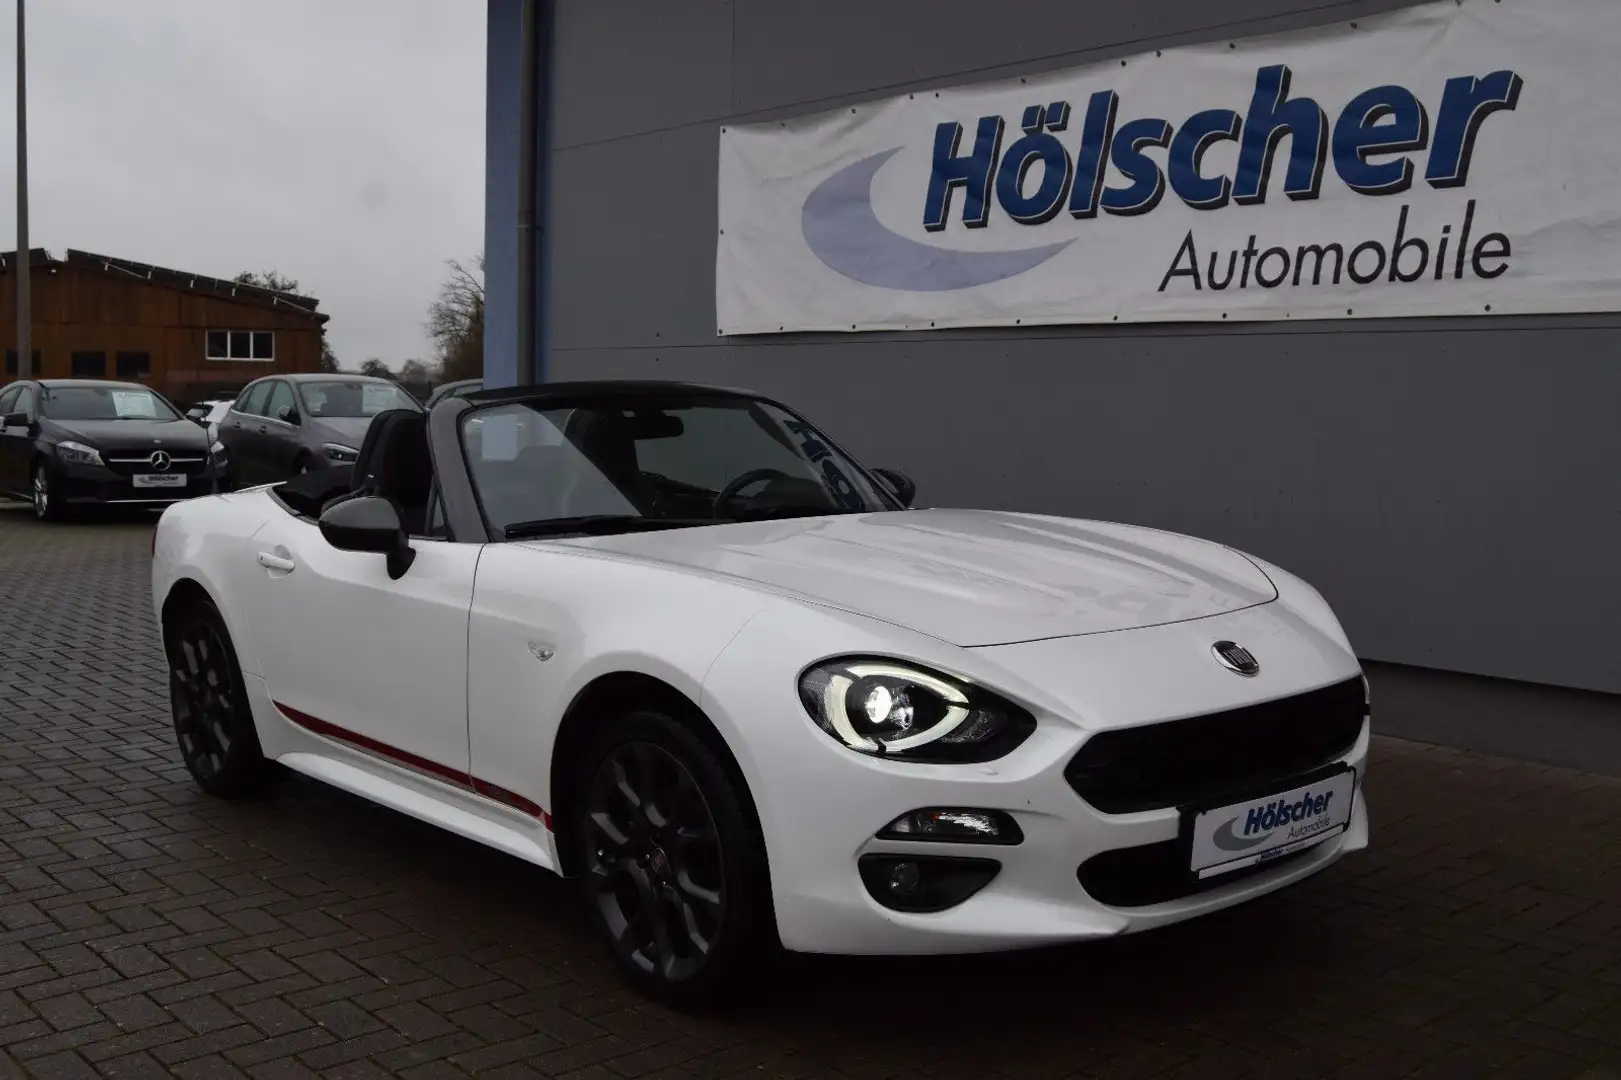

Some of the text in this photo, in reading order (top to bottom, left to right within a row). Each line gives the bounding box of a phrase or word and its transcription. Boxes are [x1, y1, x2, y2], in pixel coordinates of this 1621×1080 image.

[923, 64, 1523, 231] Hölscher
[1158, 201, 1512, 291] Automobile
[1243, 790, 1334, 836] Hölscher
[1286, 813, 1331, 840] Automobile
